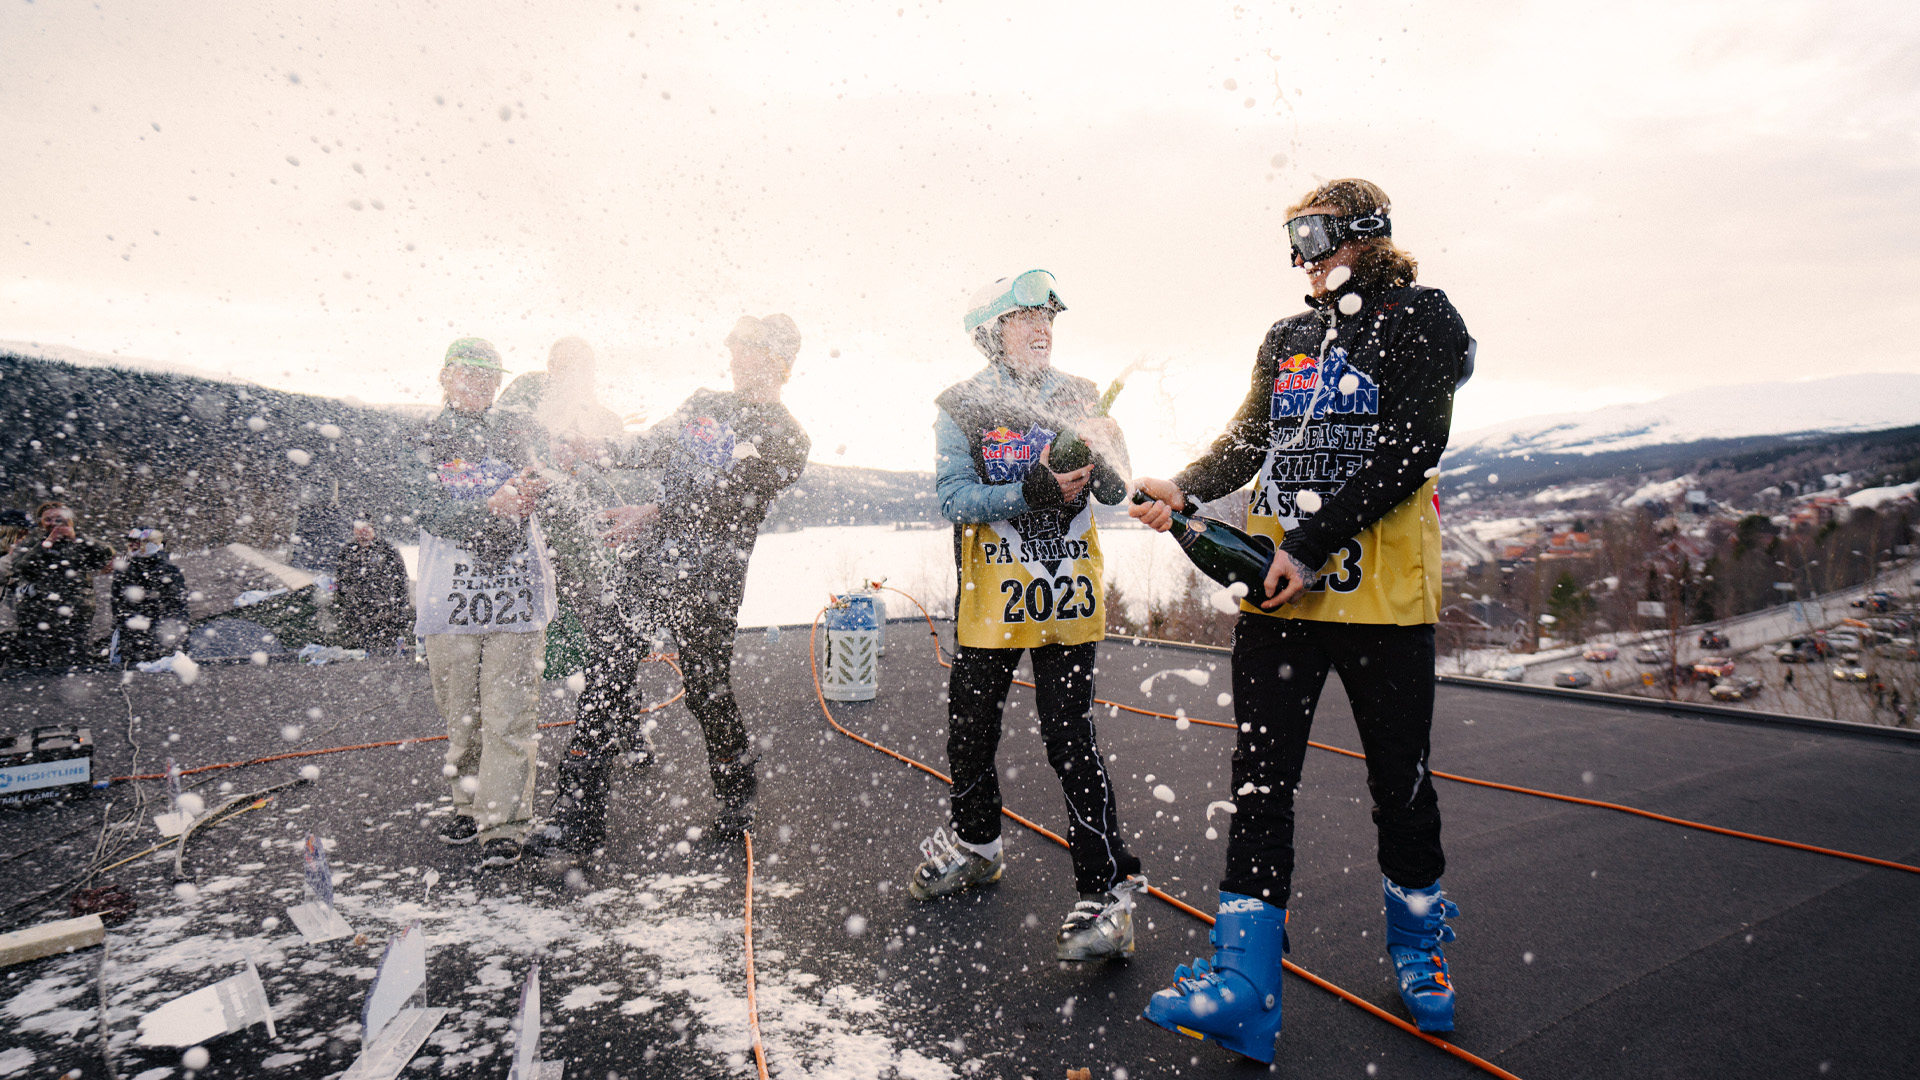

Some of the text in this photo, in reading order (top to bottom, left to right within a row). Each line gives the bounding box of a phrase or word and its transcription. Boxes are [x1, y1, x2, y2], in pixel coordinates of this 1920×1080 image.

[981, 445, 1031, 460] Red Bull
[984, 537, 1014, 564] PÅ
[447, 588, 535, 627] 2023
[1000, 574, 1096, 624] 2023
[1218, 898, 1265, 914] NGE
